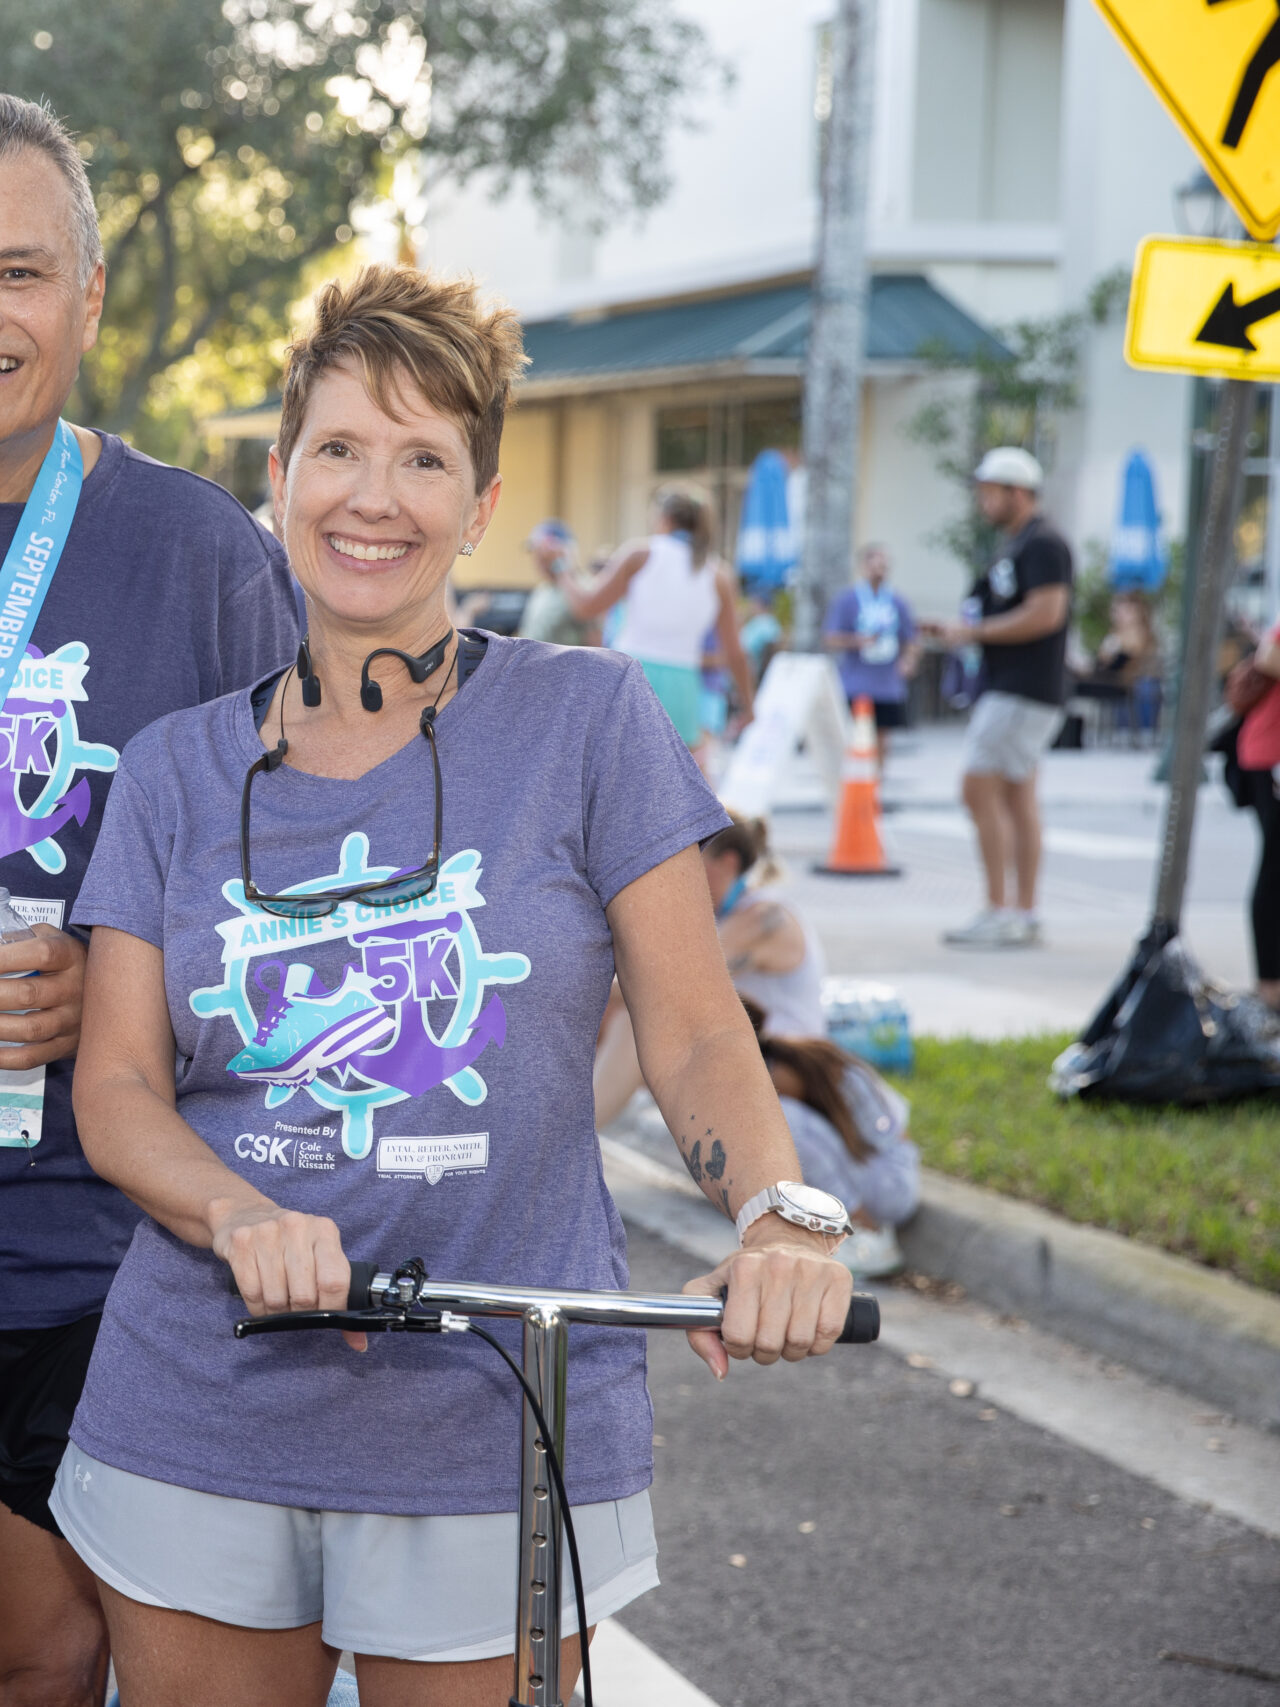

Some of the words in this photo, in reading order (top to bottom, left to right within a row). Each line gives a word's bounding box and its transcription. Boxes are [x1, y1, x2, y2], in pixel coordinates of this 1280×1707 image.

[41, 508, 56, 525] FL
[240, 907, 349, 948] ANNIE'S
[354, 881, 457, 923] CHOICE
[366, 938, 459, 1002] 5K
[274, 1120, 320, 1136] Presented
[322, 1126, 337, 1138] By
[234, 1133, 293, 1167] CSK
[300, 1141, 321, 1152] Cole
[298, 1151, 322, 1161] Scott
[325, 1152, 336, 1162] &
[298, 1160, 335, 1170] Kissane
